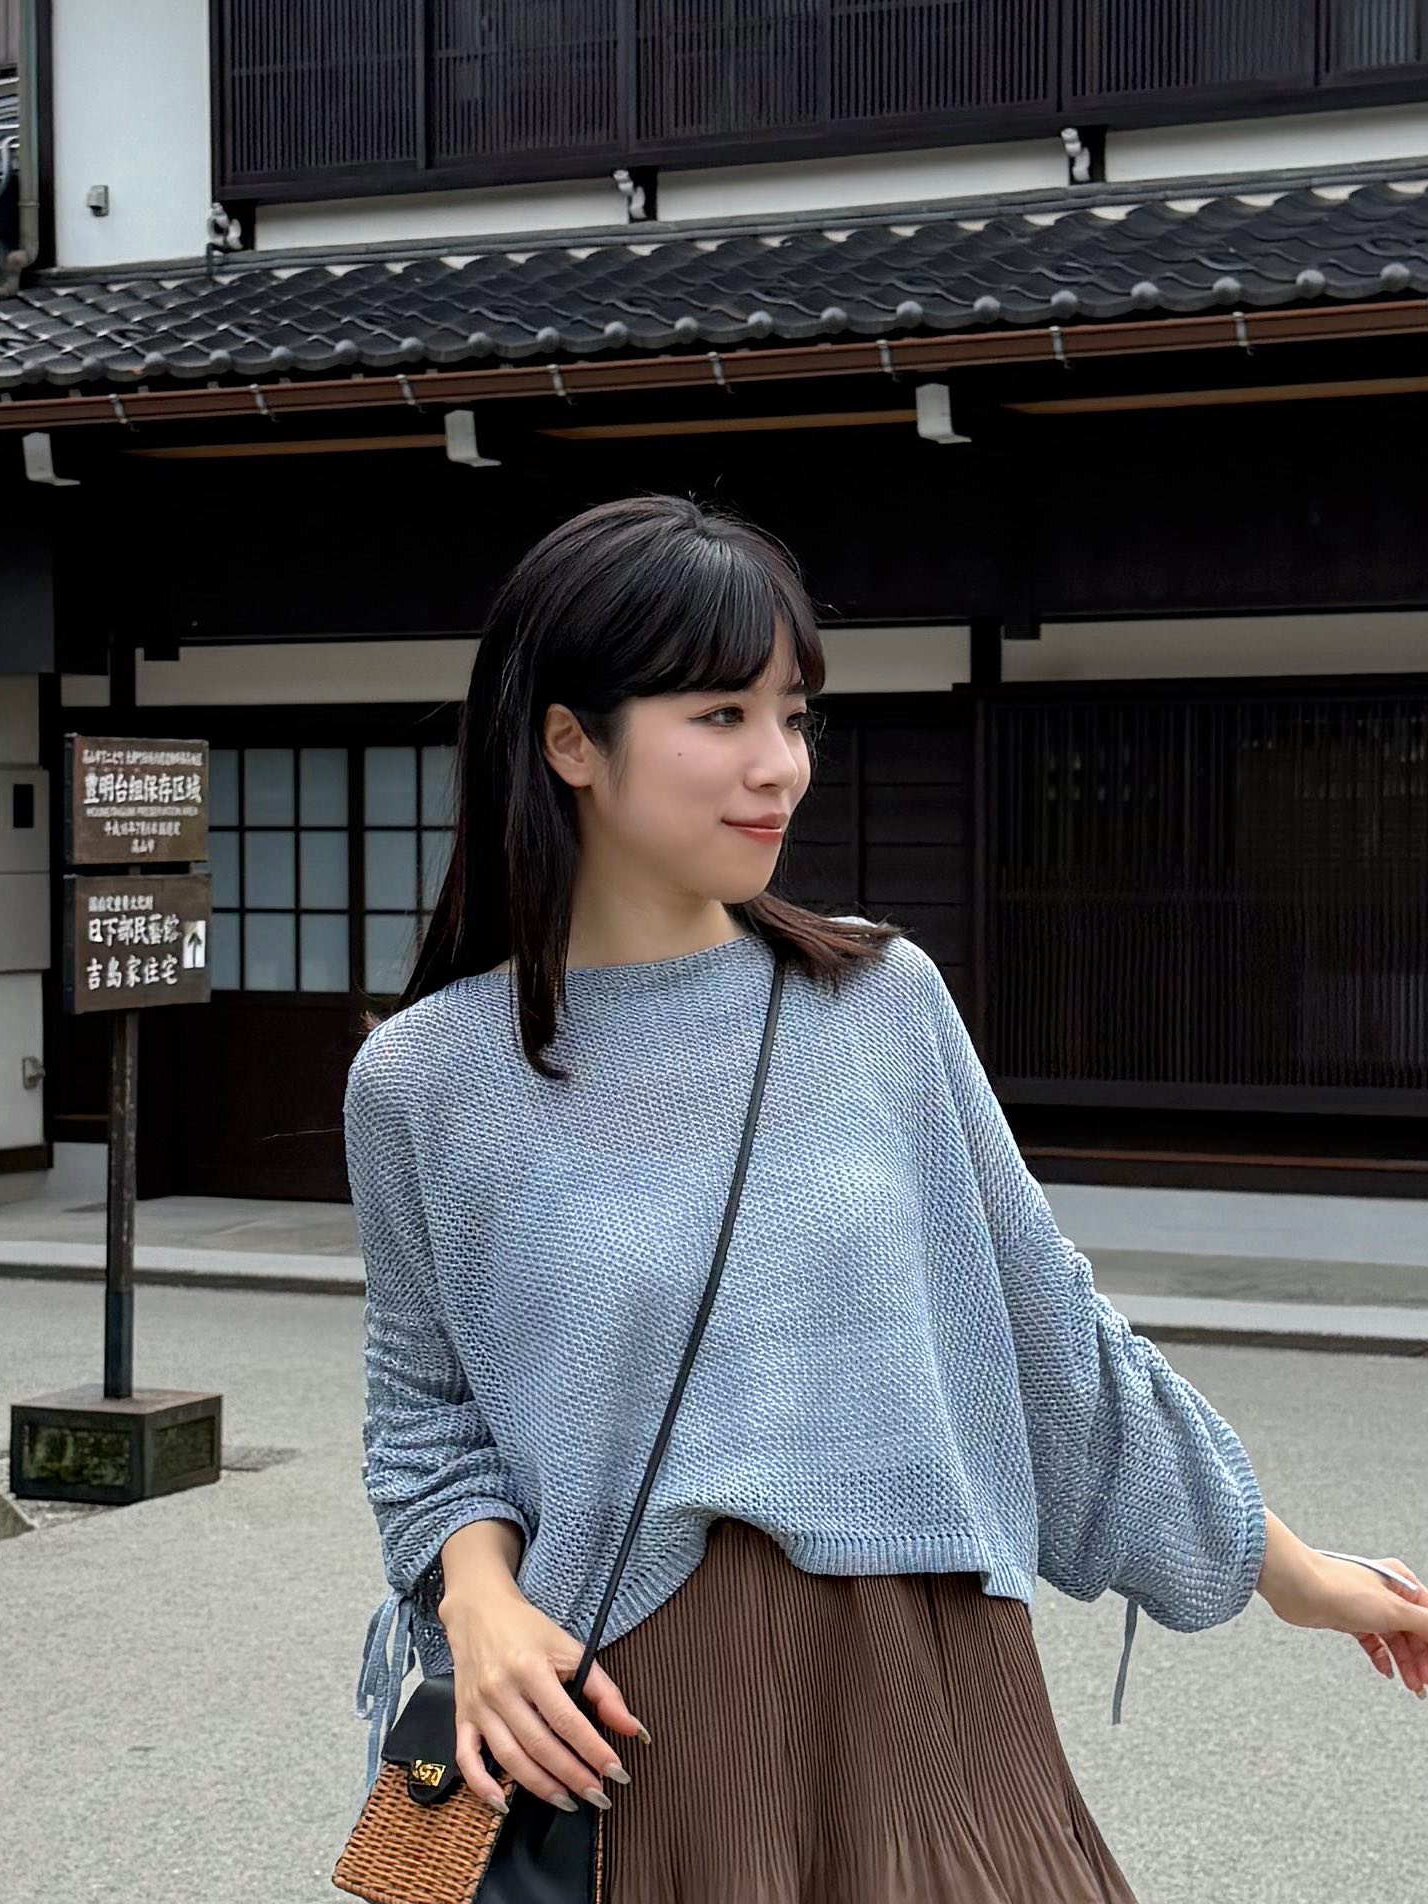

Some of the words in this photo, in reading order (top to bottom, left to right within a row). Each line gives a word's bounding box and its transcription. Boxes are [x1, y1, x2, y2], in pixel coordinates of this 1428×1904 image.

[86, 953, 178, 991] 吉島家住宅
